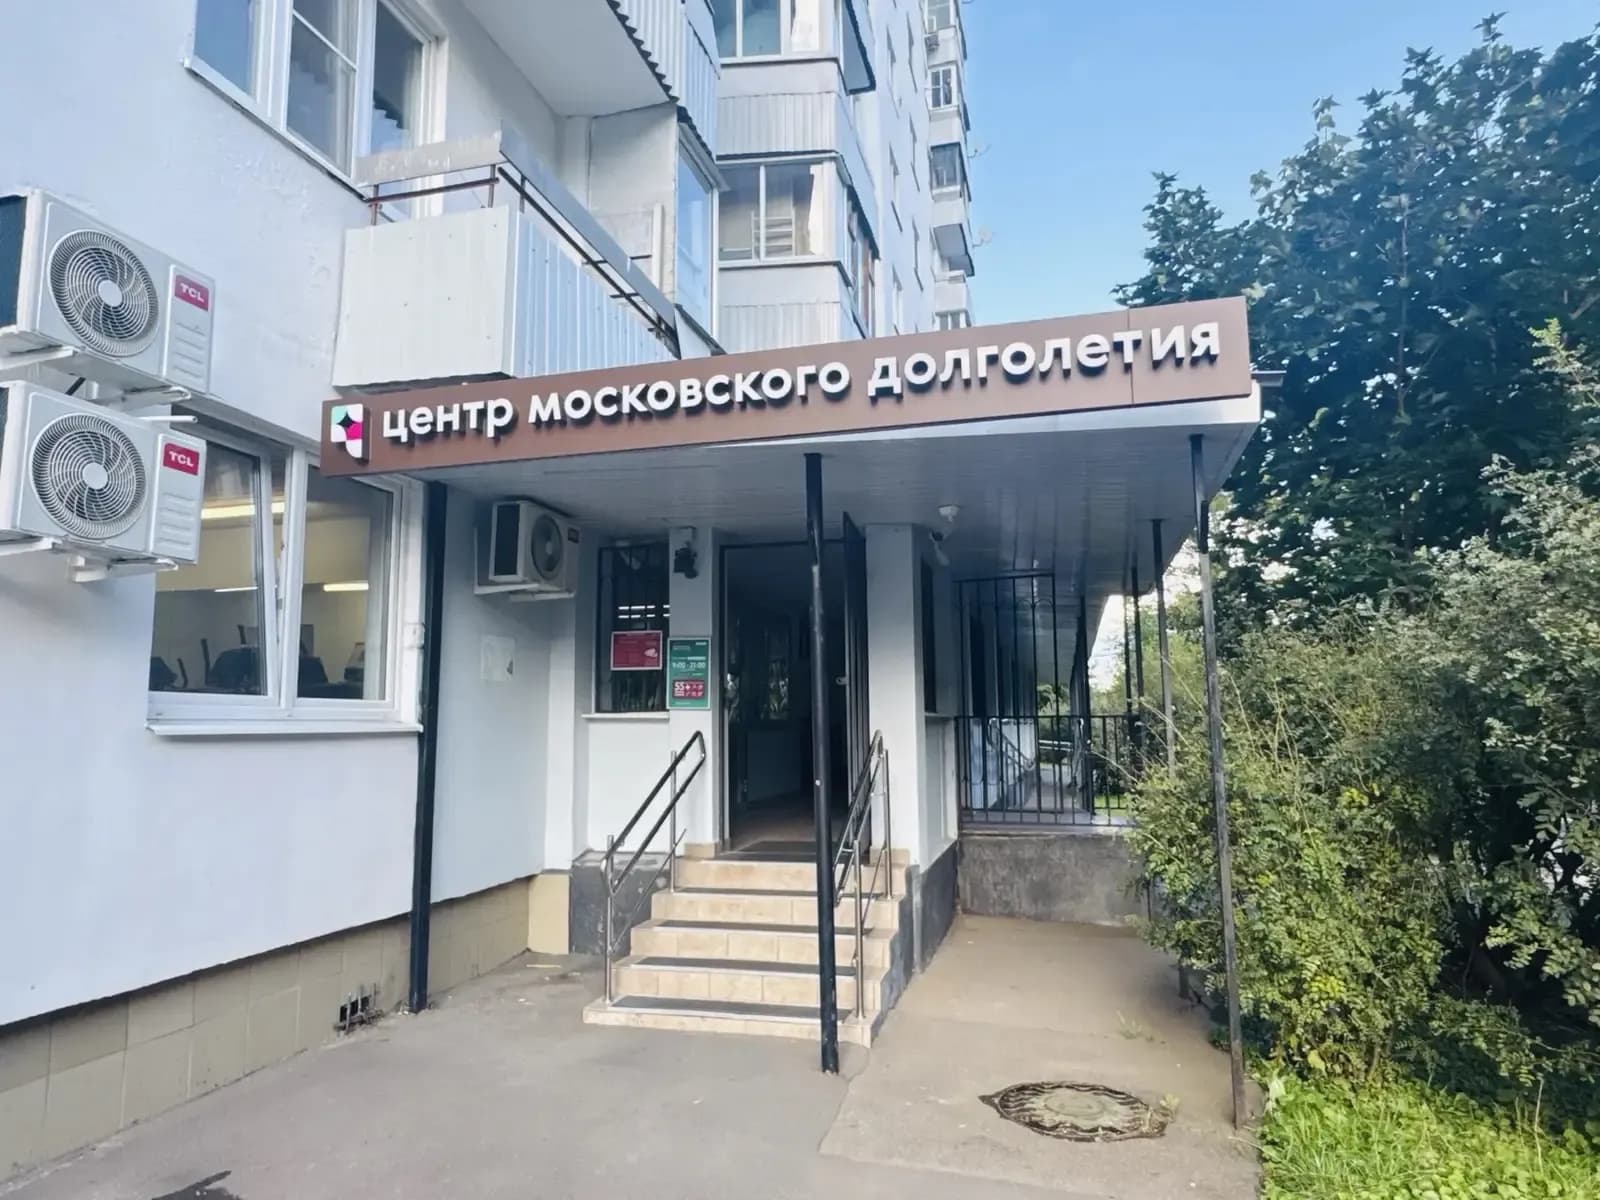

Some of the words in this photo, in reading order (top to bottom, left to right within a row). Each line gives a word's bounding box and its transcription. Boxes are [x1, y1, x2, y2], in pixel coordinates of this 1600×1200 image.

[180, 282, 205, 303] TCL
[382, 397, 514, 443] центр
[527, 361, 851, 424] московского
[867, 321, 1220, 398] долголетия
[168, 450, 195, 468] TCL
